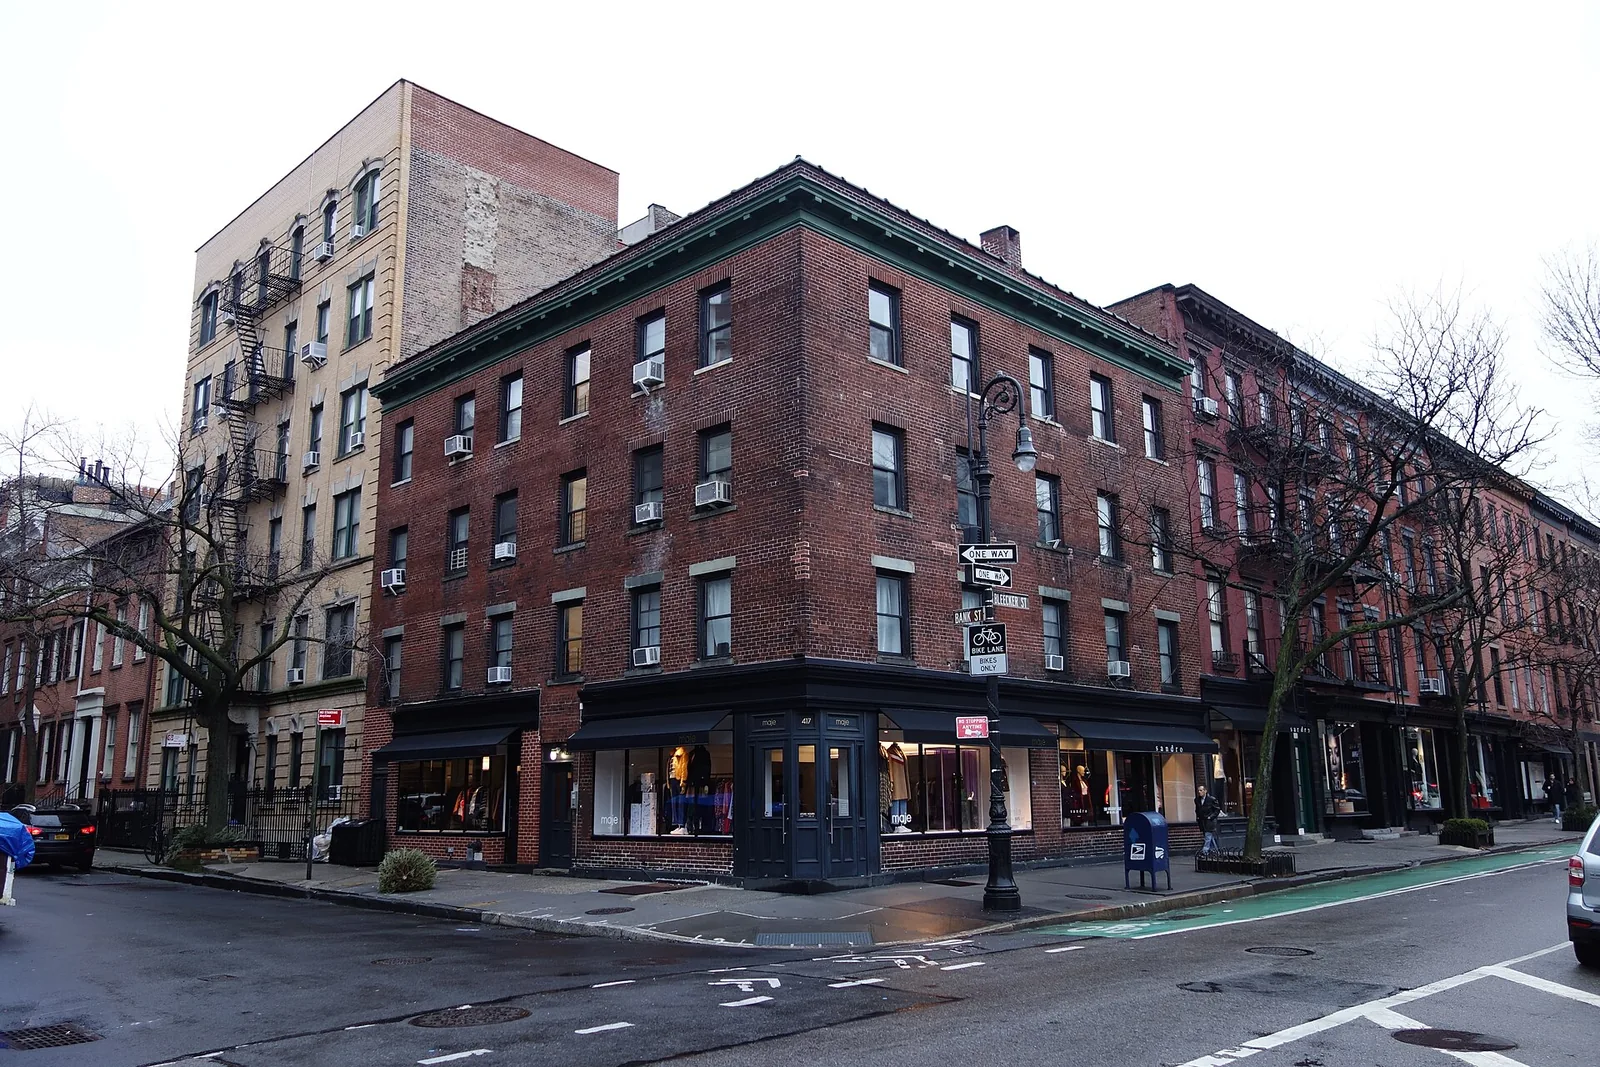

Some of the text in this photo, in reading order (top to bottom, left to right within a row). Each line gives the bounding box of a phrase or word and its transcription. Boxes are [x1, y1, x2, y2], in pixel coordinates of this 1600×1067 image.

[969, 550, 1009, 558] ONE WAY
[978, 569, 1006, 580] ONE WAY
[993, 592, 1027, 608] BLEECKER ST
[954, 609, 982, 624] BANK ST
[971, 645, 1004, 654] BIKE LANE
[979, 656, 998, 665] BIKES
[980, 664, 997, 672] ONLY
[761, 718, 777, 727] maje
[801, 717, 812, 725] 417
[835, 718, 850, 727] maje
[1155, 744, 1184, 753] sandro
[600, 815, 619, 826] maje
[891, 812, 913, 825] maje
